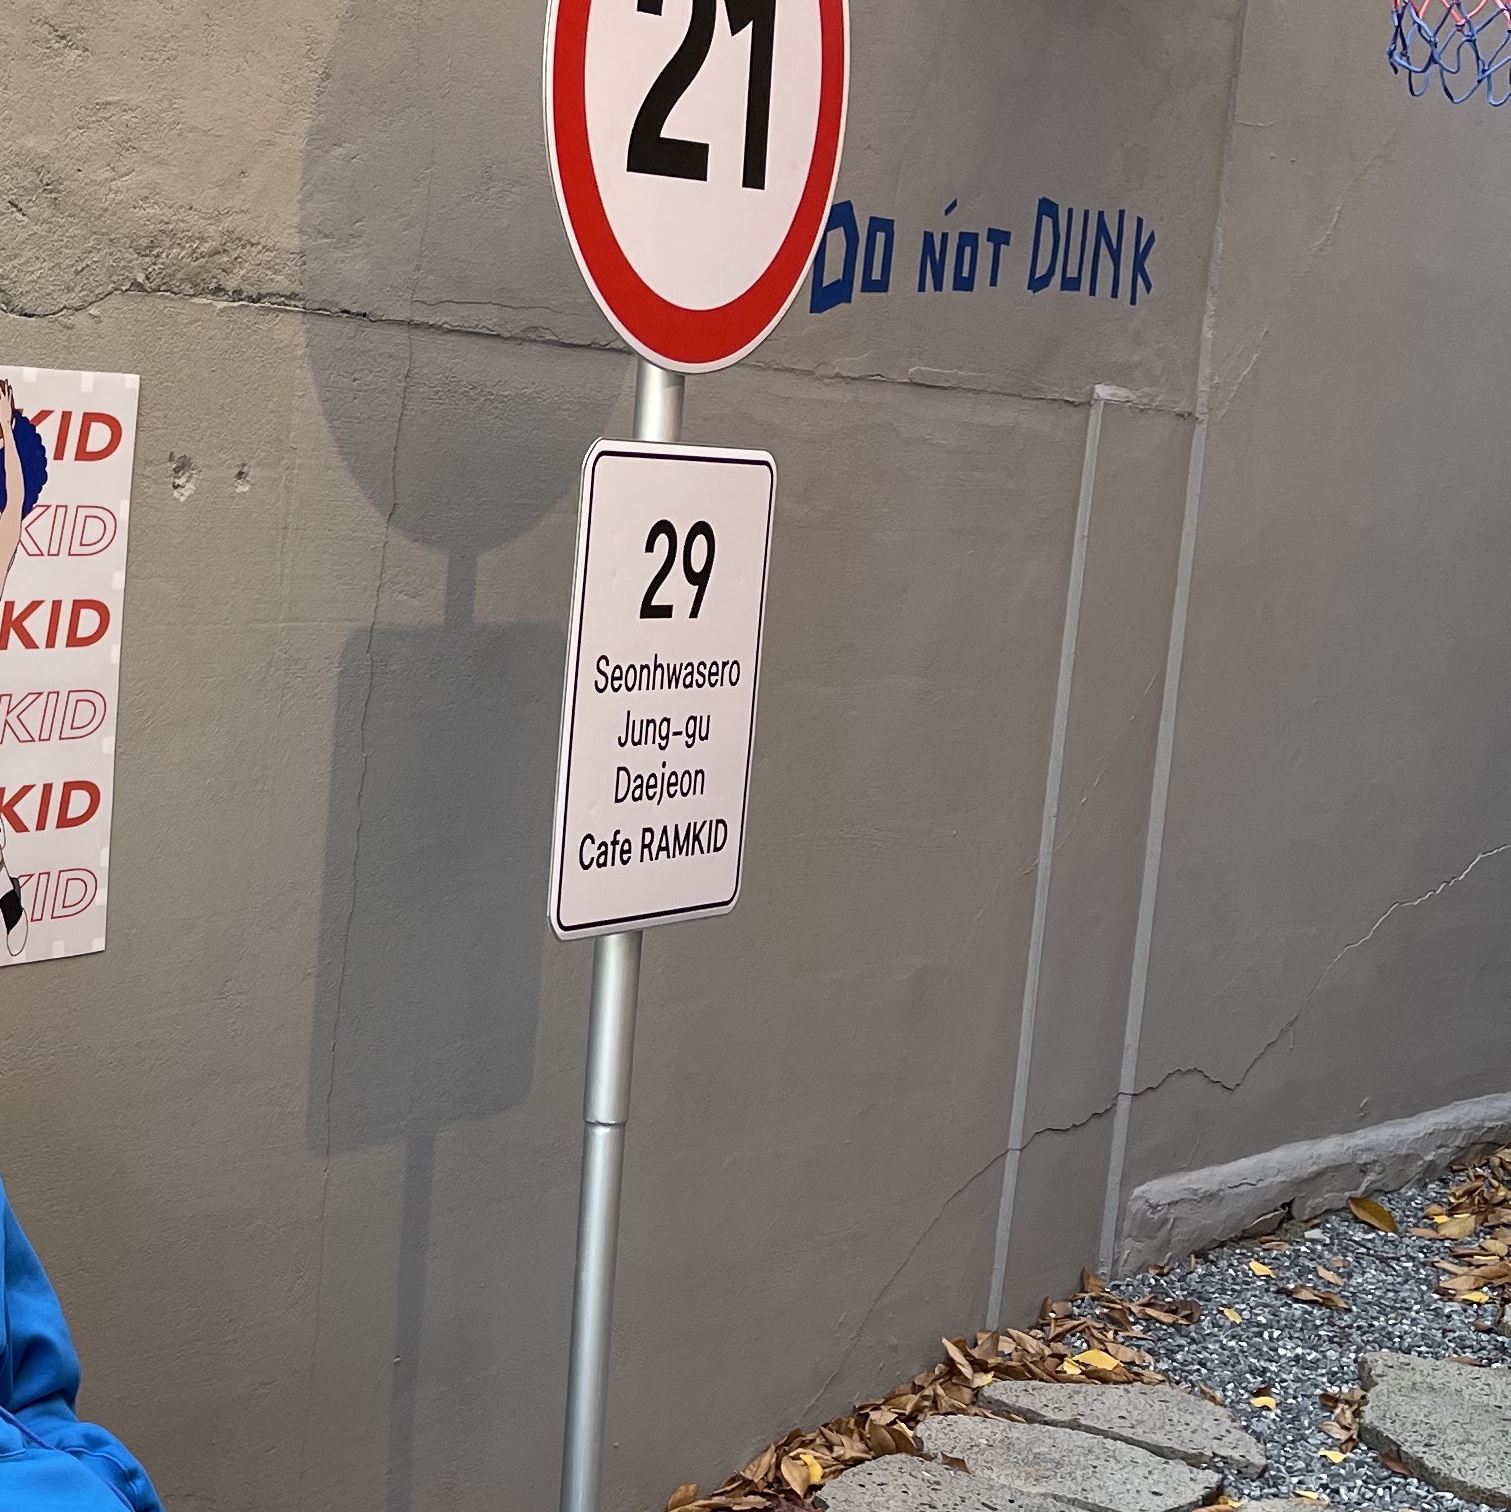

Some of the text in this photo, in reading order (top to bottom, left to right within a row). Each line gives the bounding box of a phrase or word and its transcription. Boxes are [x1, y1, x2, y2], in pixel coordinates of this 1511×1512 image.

[626, 0, 776, 190] 21
[809, 200, 895, 313] DO
[1027, 197, 1156, 305] DUNK
[639, 518, 716, 619] 29
[594, 653, 741, 694] Seonhwasero
[617, 710, 711, 751] Jung-gu
[614, 760, 706, 805] Daejeon
[579, 818, 729, 870] Cafe RAMKID
